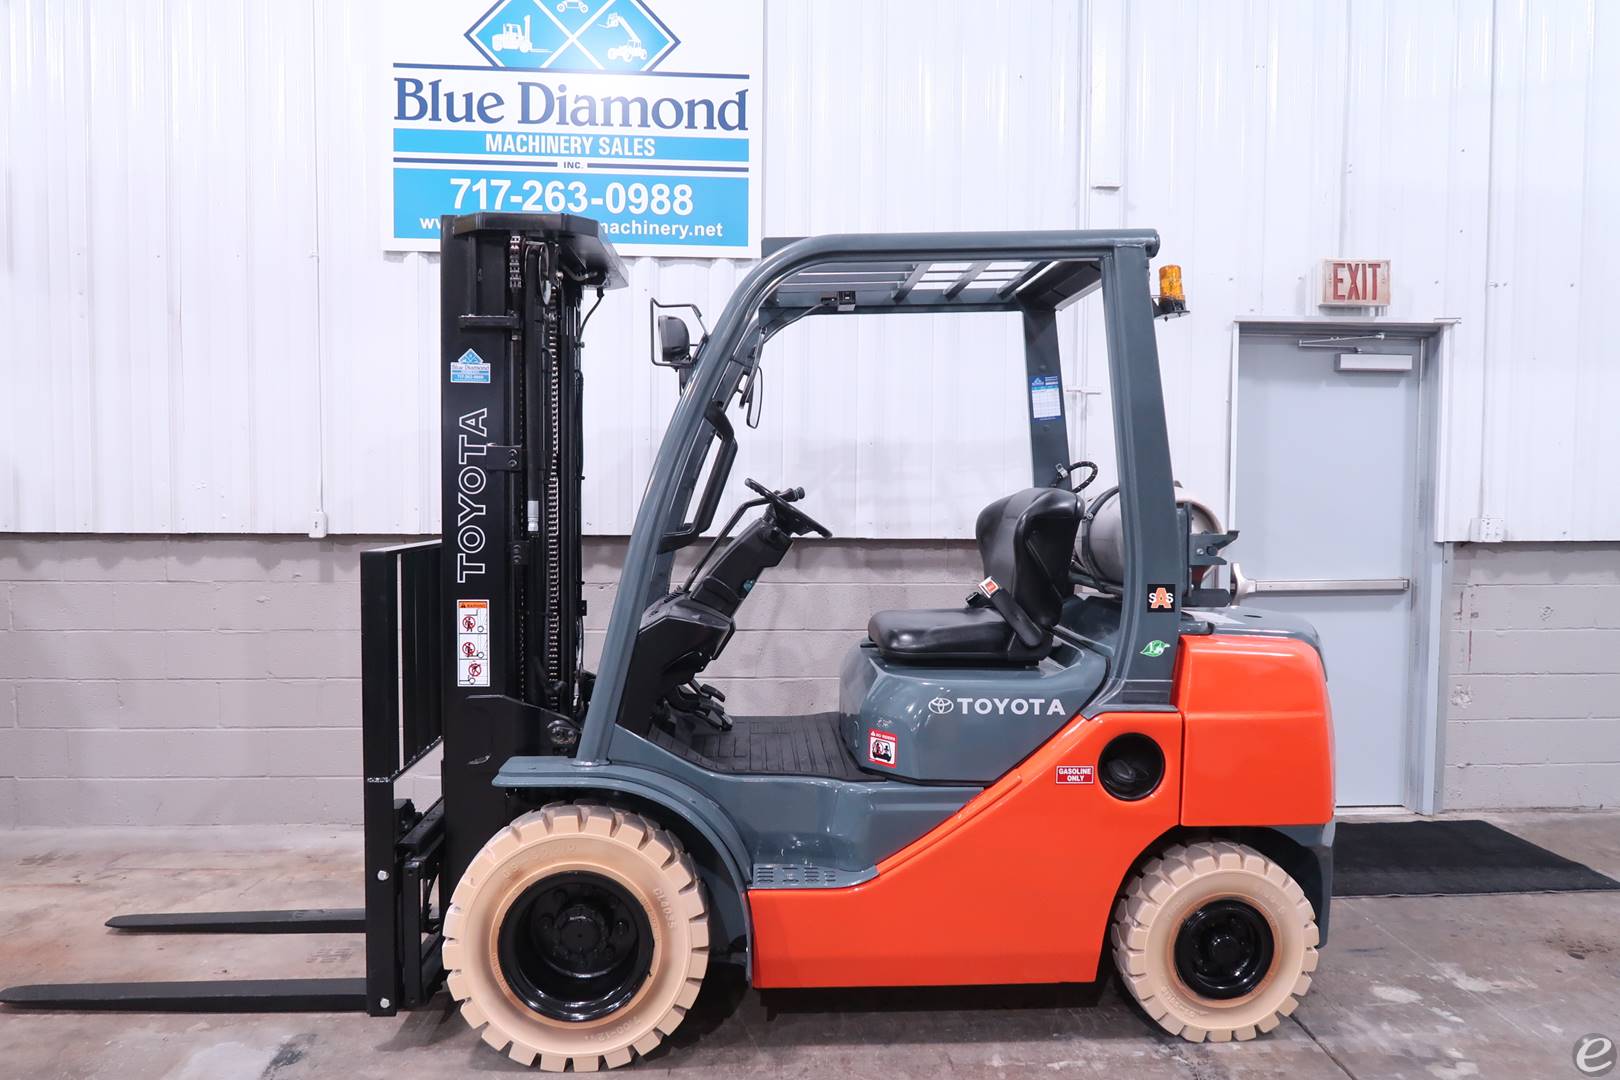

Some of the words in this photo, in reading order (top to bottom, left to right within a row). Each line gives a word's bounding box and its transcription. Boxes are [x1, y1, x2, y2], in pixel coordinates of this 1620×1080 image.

[393, 77, 505, 123] Blue
[517, 81, 749, 131] Diamond
[485, 133, 593, 155] MACHINERY
[598, 136, 656, 156] SALES
[563, 161, 584, 169] INC.
[450, 178, 694, 216] 717-263-0988
[1332, 262, 1381, 301] EXIT
[457, 407, 488, 584] TOYOTA
[1148, 587, 1174, 609] SAS
[956, 697, 1066, 716] TOYOTA
[1058, 767, 1092, 775] GASOLINE
[1066, 774, 1085, 782] ONLY
